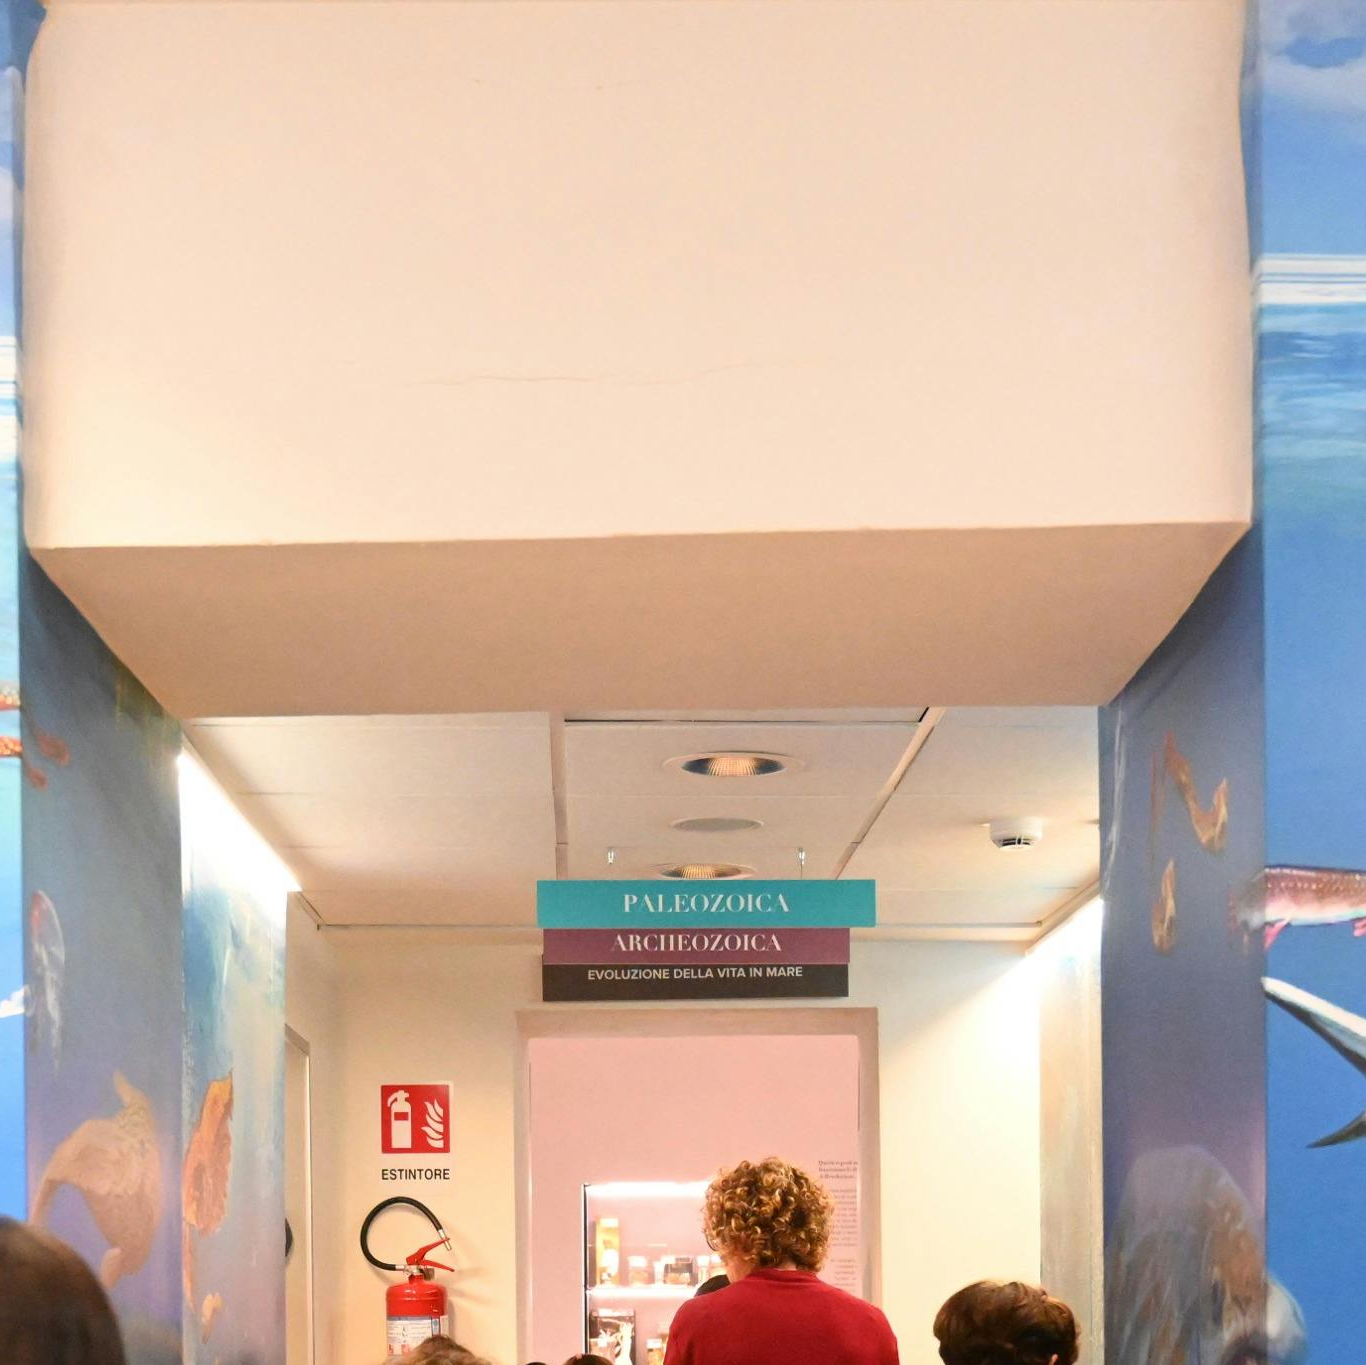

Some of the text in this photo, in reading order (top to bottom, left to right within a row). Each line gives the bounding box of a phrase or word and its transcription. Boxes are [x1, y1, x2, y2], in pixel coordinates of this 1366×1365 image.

[623, 893, 790, 913] PALEOZOICA
[611, 933, 782, 952] ARCHEOZOICA
[587, 966, 803, 980] EVOLUZIONE DELLA VITA IN MARE
[381, 1168, 450, 1181] ESTINTORE
